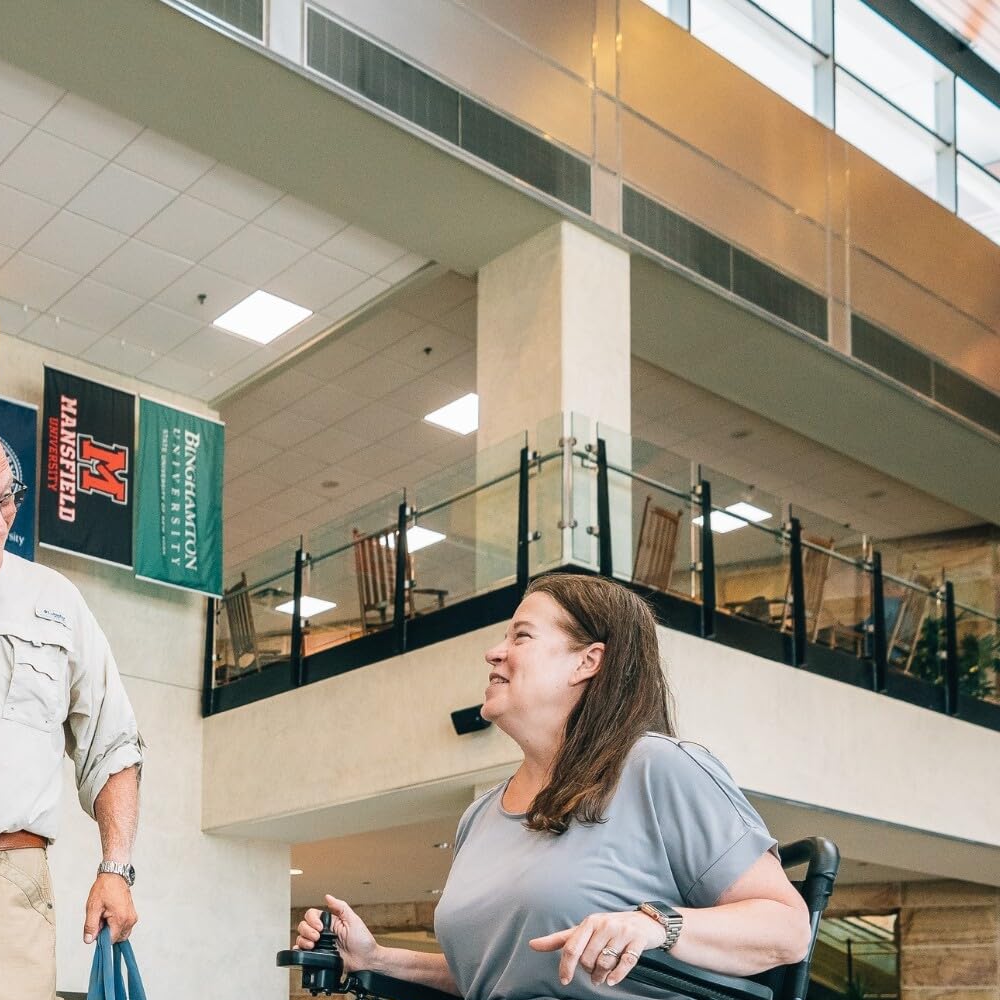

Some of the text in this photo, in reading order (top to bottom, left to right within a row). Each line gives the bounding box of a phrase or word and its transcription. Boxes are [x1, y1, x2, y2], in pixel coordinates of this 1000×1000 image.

[48, 417, 59, 492] UNIVERSITY
[59, 395, 77, 522] MANSFIELD
[171, 428, 181, 566] UNIVERSITY
[185, 429, 200, 571] BINGHAMTON
